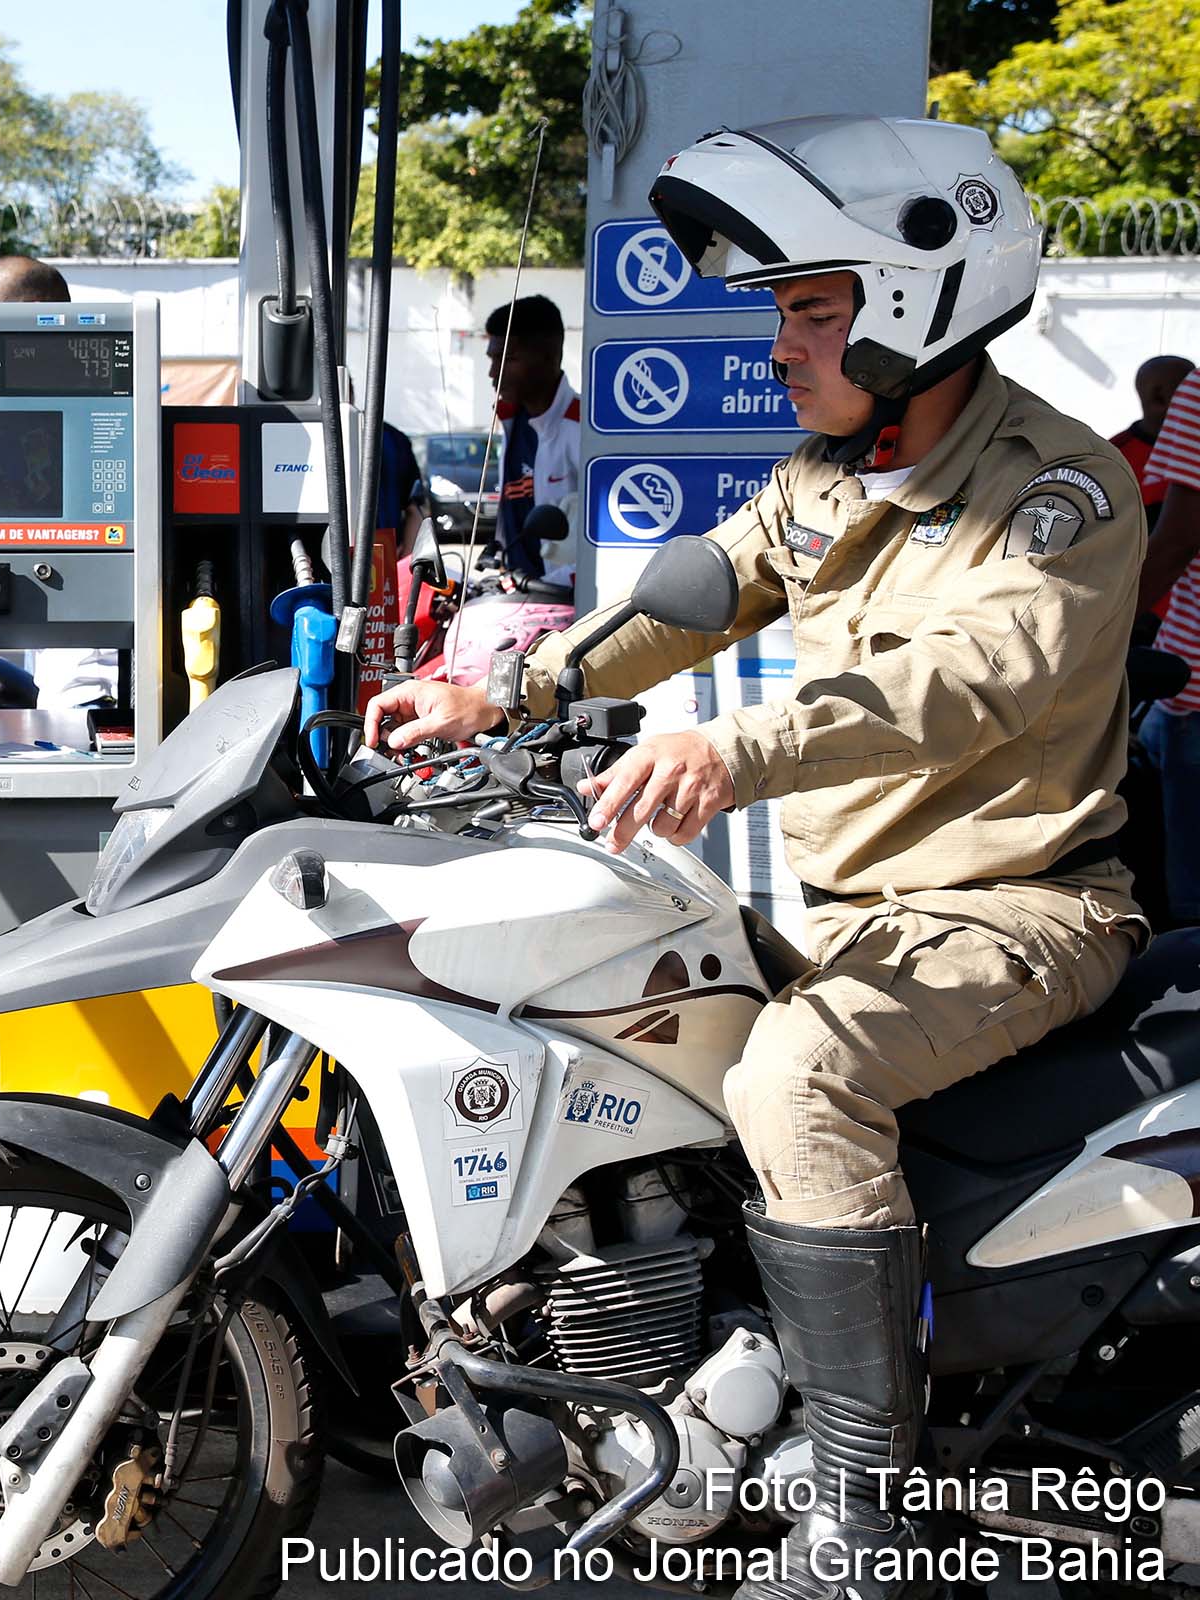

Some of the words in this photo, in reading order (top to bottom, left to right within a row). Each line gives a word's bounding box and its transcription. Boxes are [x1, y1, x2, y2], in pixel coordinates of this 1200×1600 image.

[722, 388, 783, 413] abrir
[181, 465, 236, 480] Clean
[1056, 468, 1109, 515] MUNICIPAL
[9, 527, 24, 540] DE
[27, 527, 100, 541] VANTAGENS?
[458, 1071, 478, 1093] GUARDA
[478, 1070, 506, 1087] MUNICIPAL
[597, 1093, 642, 1125] RIO
[594, 1119, 633, 1135] PREFEITURA
[453, 1151, 508, 1177] 1746
[481, 1185, 496, 1195] RIO
[647, 1516, 710, 1527] HONDA
